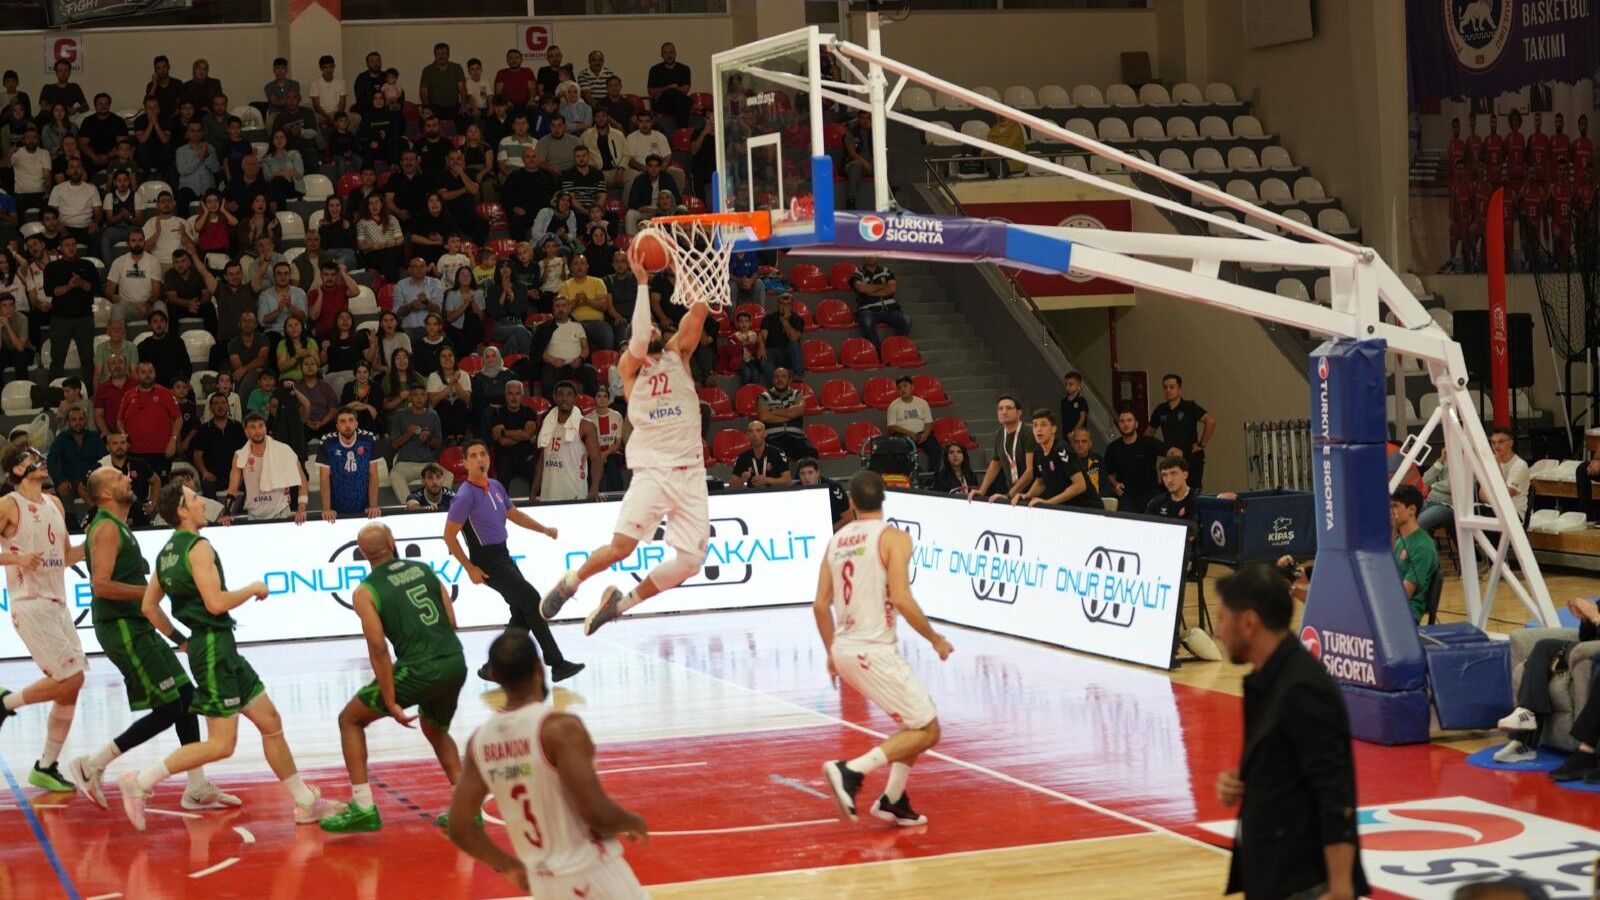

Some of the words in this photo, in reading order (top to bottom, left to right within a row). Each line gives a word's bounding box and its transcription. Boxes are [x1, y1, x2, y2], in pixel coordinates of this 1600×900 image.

[1522, 0, 1590, 27] BASKETBO
[54, 38, 77, 64] G
[526, 26, 548, 51] G
[1523, 33, 1566, 61] TAKIMI
[886, 228, 944, 245] SİGORTA
[648, 372, 672, 397] 22
[551, 436, 562, 452] 15
[47, 524, 55, 546] 6
[701, 531, 816, 565] AKALİT
[264, 566, 367, 595] ONUR
[840, 560, 854, 606] 8
[949, 550, 987, 577] ONUR
[990, 555, 1048, 588] BAKALİT
[1056, 566, 1099, 598] ONUR
[1103, 575, 1171, 610] BAKALİT
[406, 585, 440, 626] 5
[1322, 630, 1374, 661] TÜRKİYE
[1323, 654, 1377, 685] SİGORTA
[484, 737, 530, 763] BRANDON
[511, 784, 543, 848] 3
